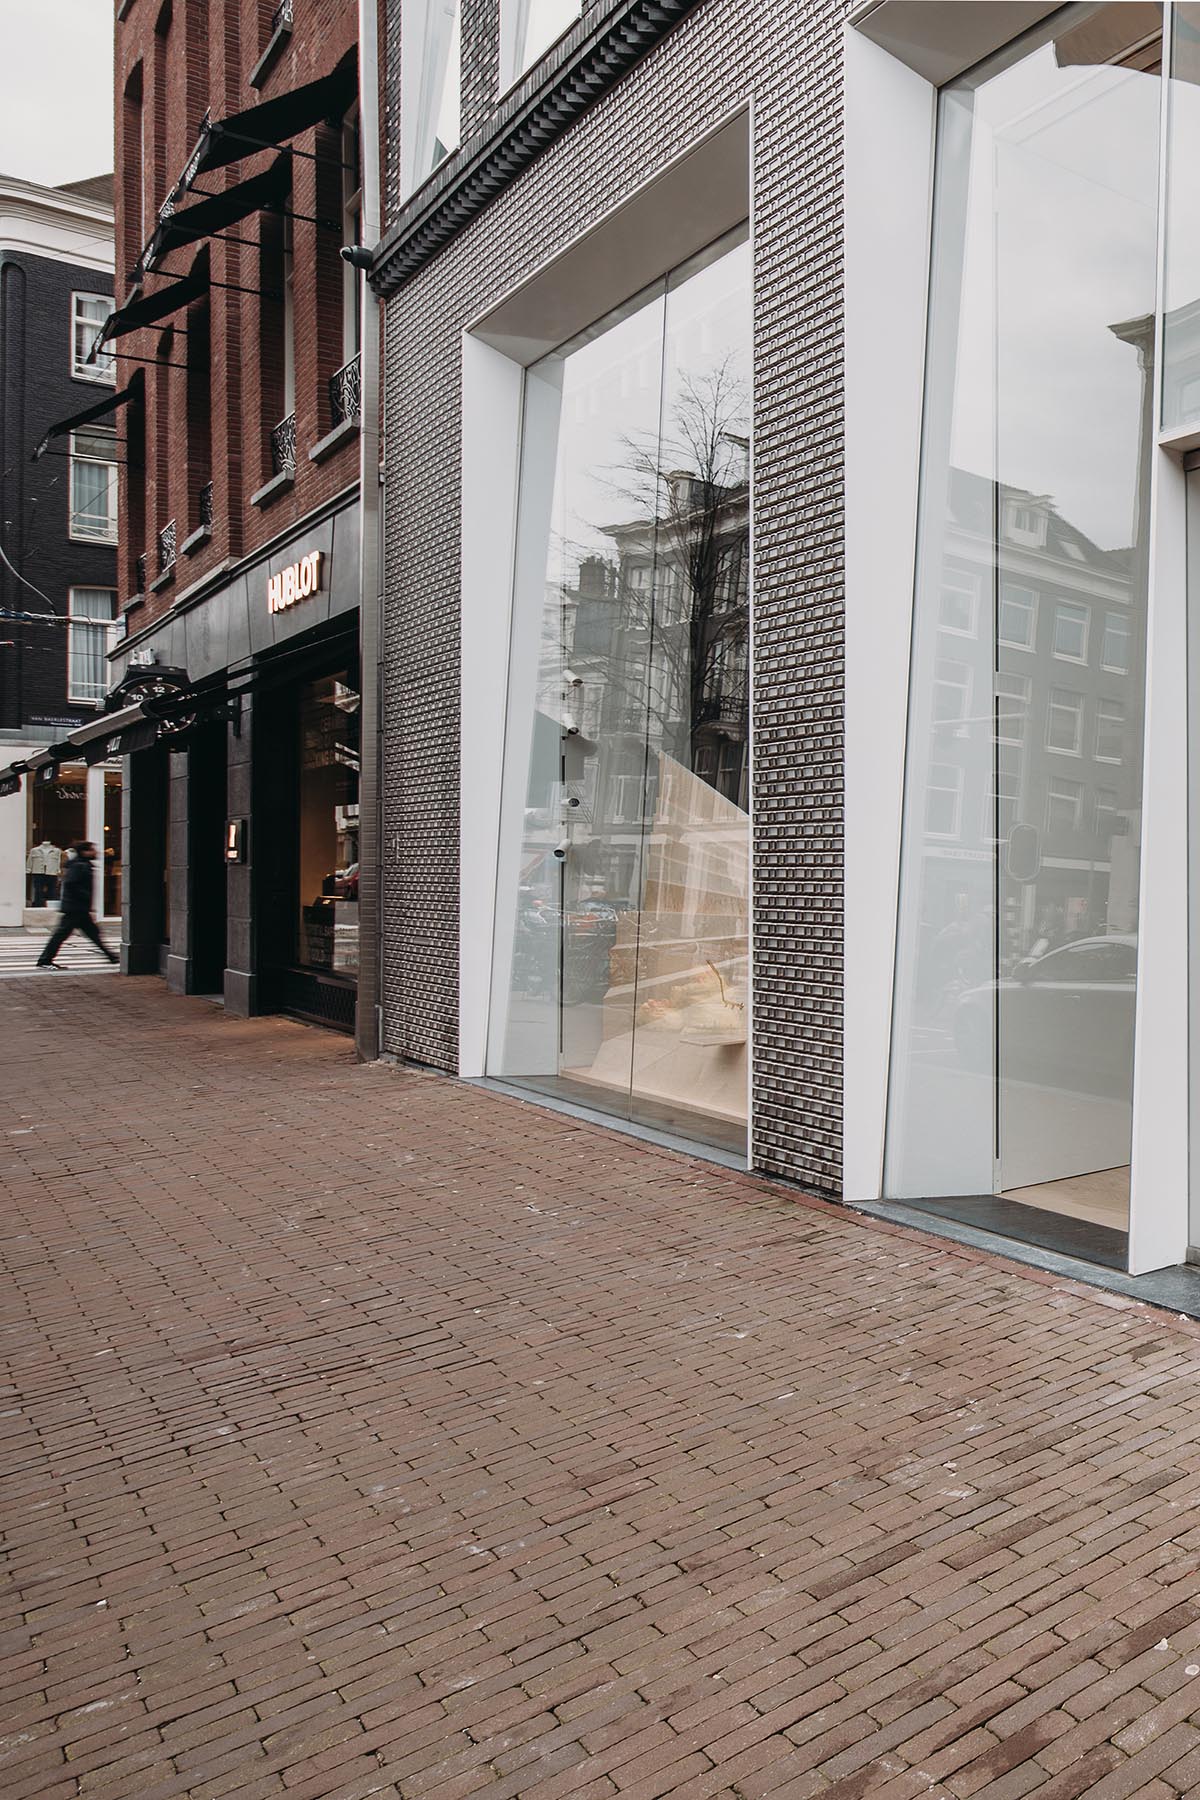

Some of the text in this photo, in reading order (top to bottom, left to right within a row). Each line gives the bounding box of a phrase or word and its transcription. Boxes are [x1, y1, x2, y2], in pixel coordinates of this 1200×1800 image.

[268, 550, 320, 614] HUBLOT
[152, 686, 166, 694] 12
[130, 693, 144, 701] 10
